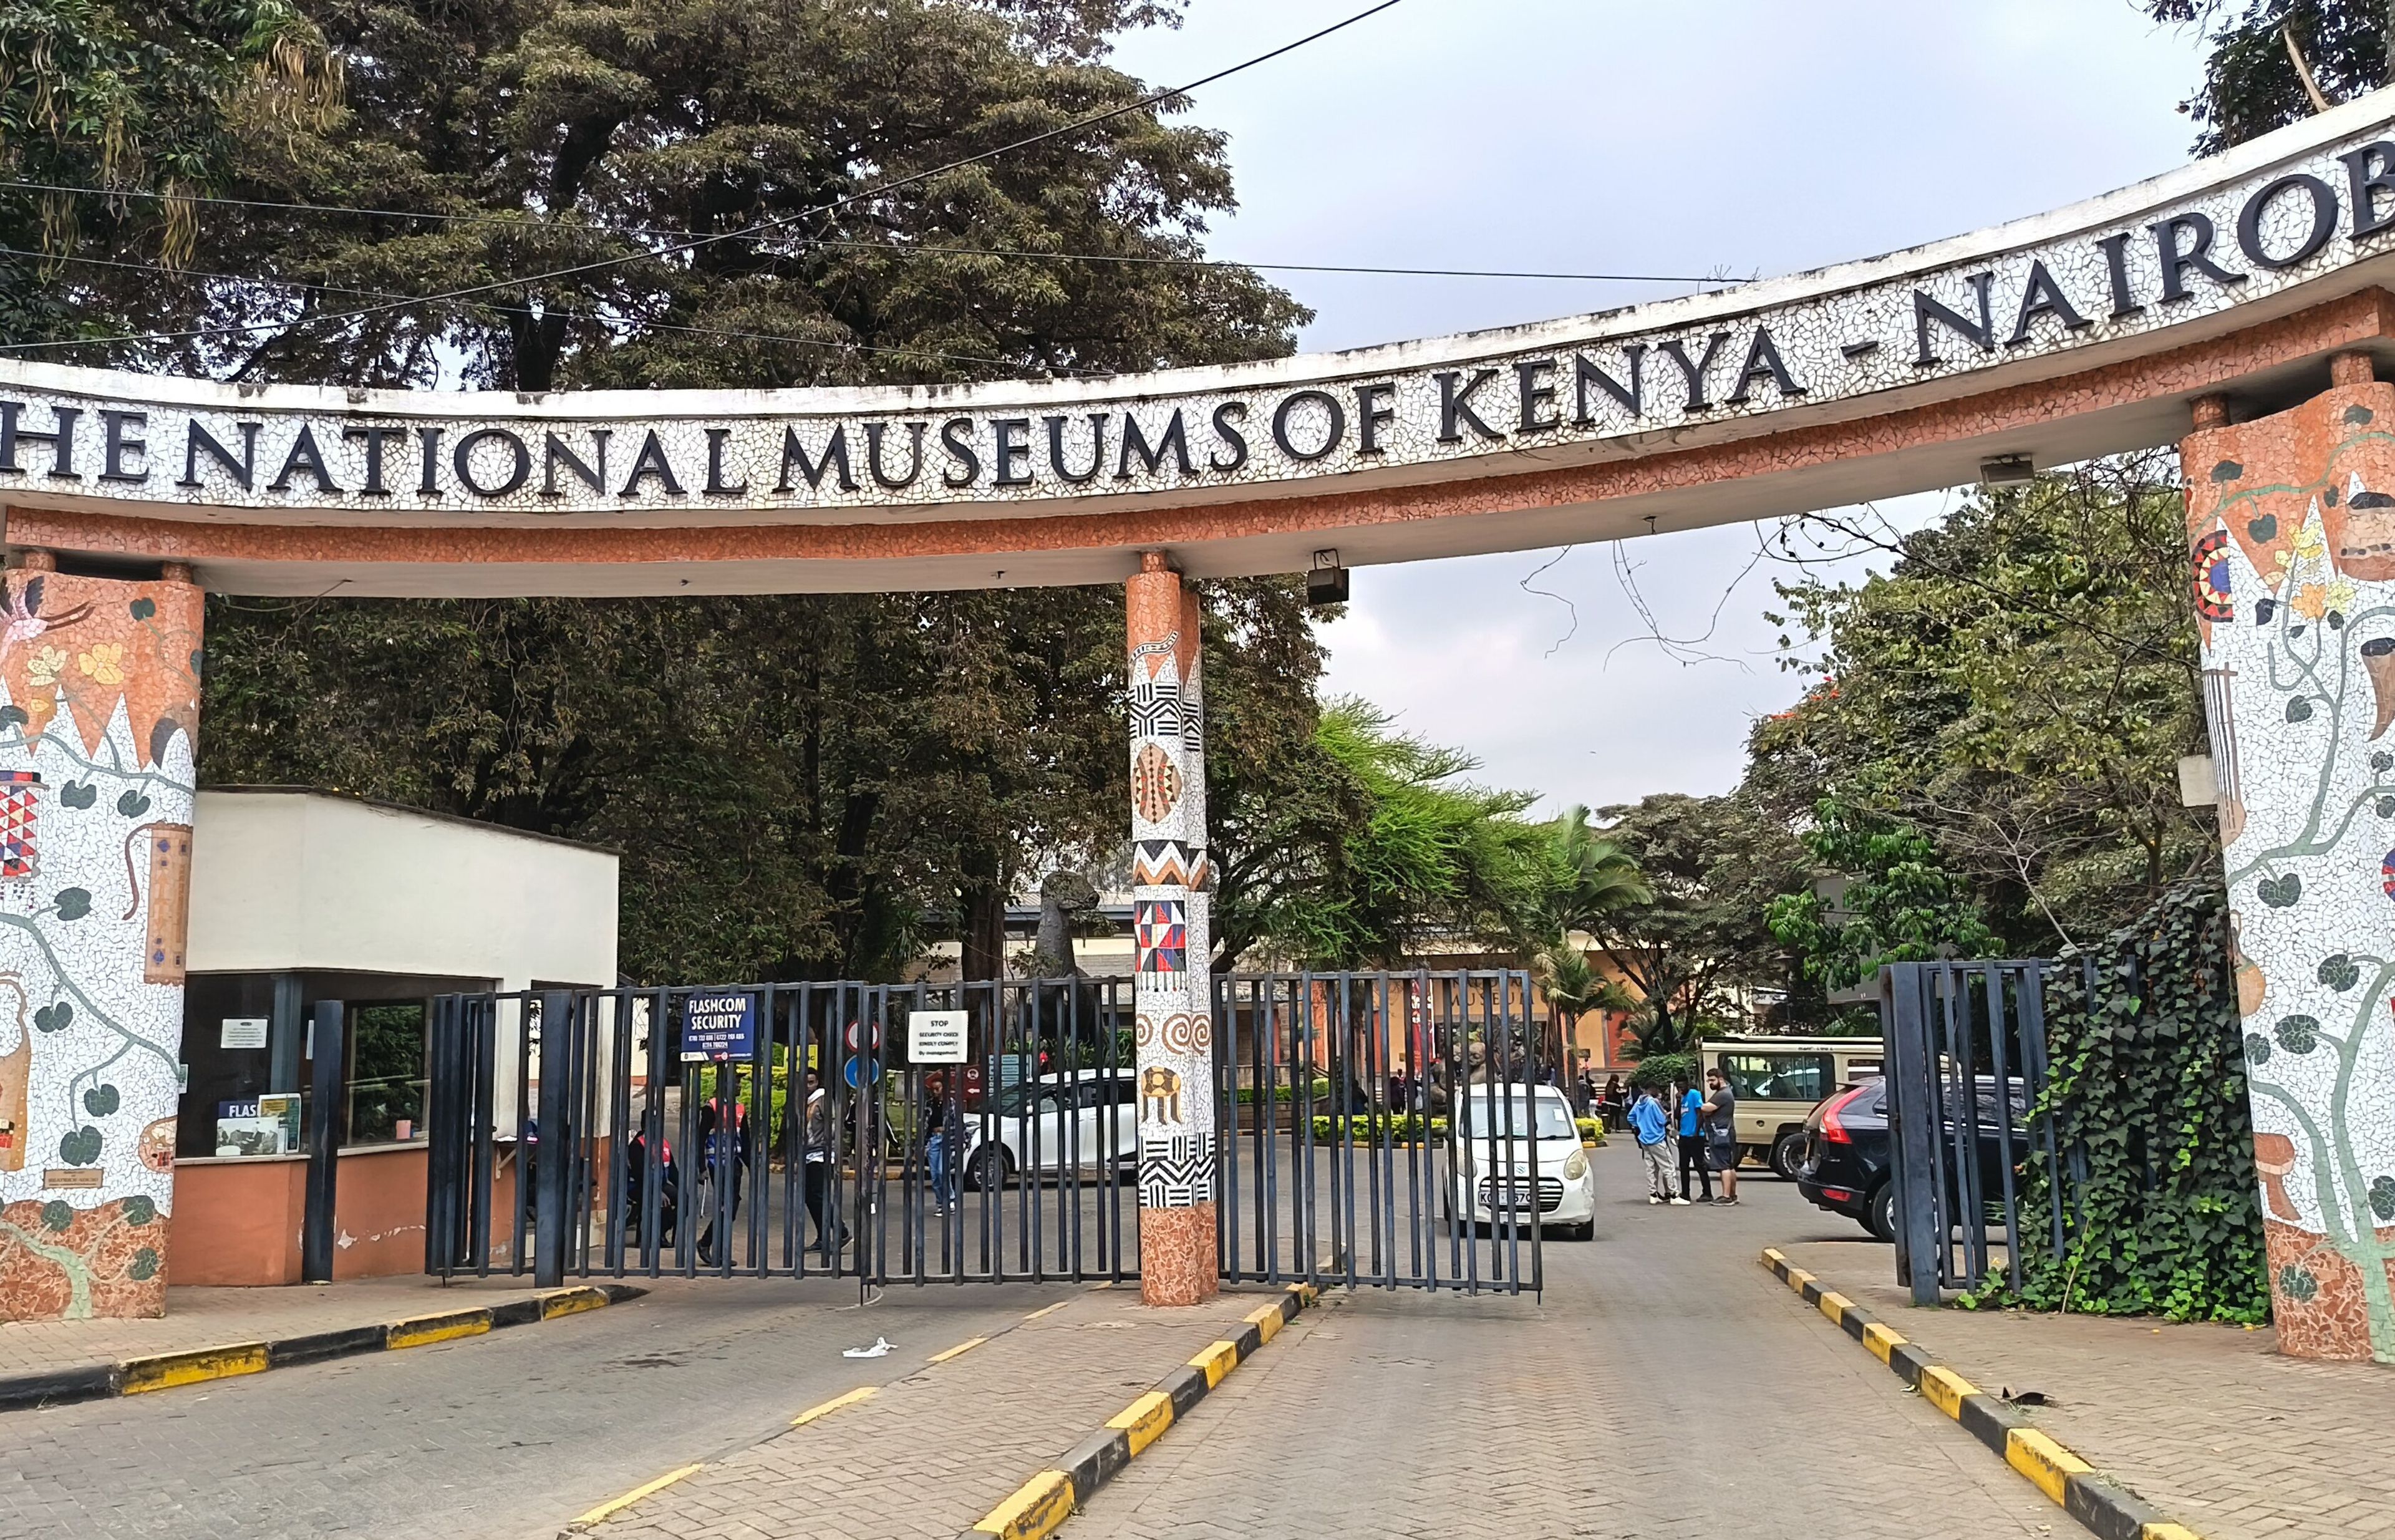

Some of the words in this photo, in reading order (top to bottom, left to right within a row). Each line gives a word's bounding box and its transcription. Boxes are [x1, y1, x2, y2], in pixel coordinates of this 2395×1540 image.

[175, 419, 748, 498] NATIONAL
[772, 401, 1248, 492] MUSEUMS
[1272, 382, 1395, 461] OF
[1432, 324, 1806, 443] KENYA
[689, 998, 746, 1014] FLASHCOM
[691, 1014, 742, 1030] SECURITY
[229, 1105, 256, 1117] FLAS
